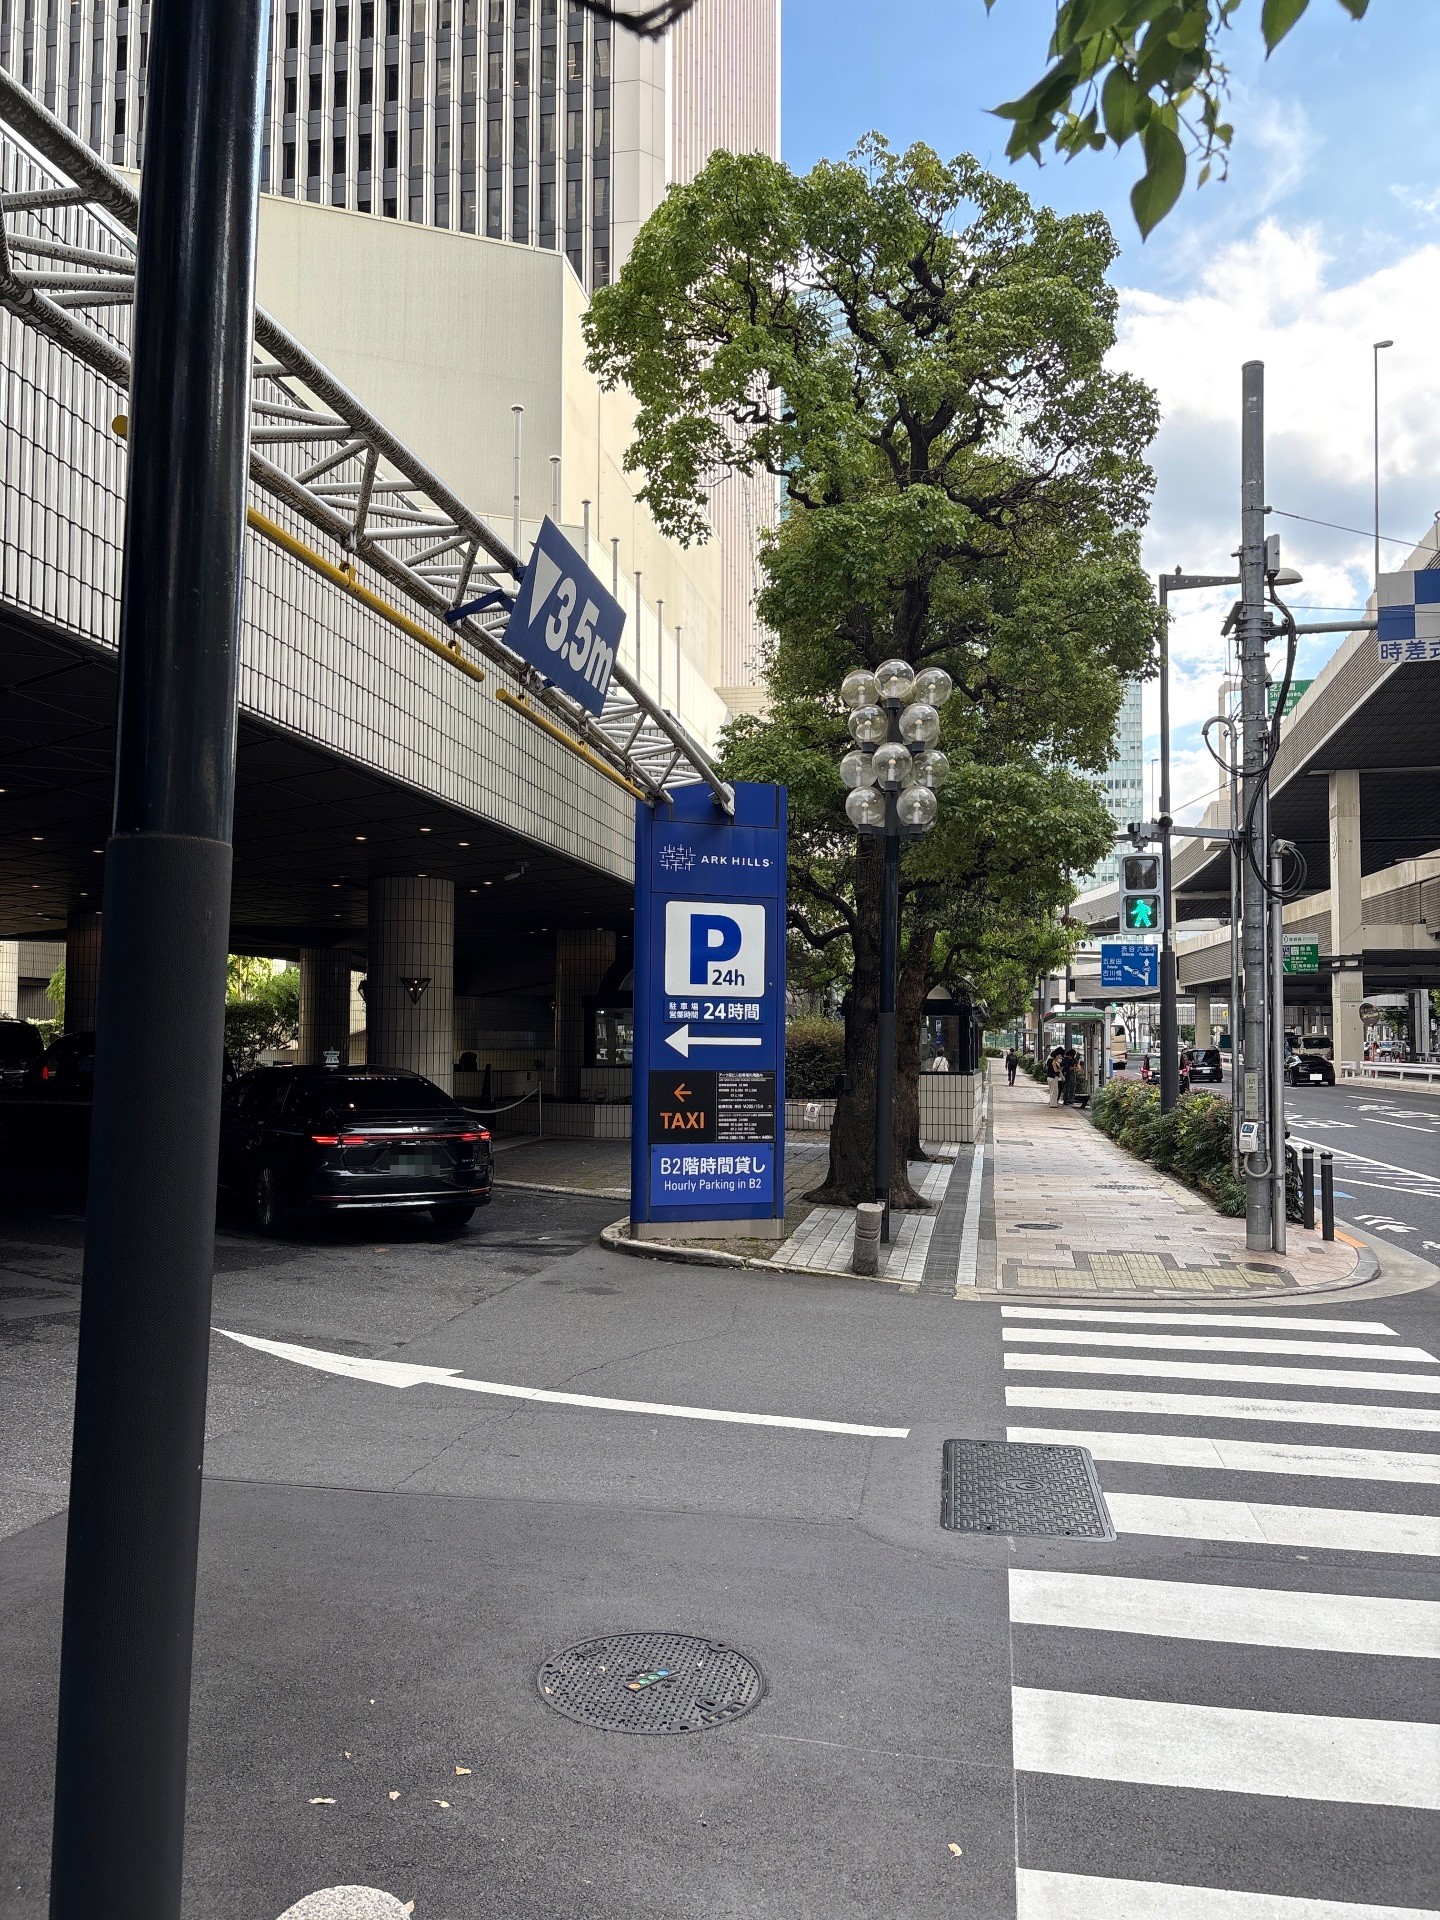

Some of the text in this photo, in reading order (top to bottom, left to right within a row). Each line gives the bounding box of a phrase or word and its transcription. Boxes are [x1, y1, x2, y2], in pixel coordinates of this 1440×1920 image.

[701, 855, 770, 868] ARK HILLS
[690, 914, 742, 985] P
[712, 968, 745, 986] 24h
[669, 1010, 699, 1019] 営業時間
[703, 1002, 760, 1020] 24時間
[660, 1111, 705, 1129] TAXI
[660, 1156, 766, 1176] B2階時間貸し
[664, 1178, 762, 1192] Hourly Parking in B2
